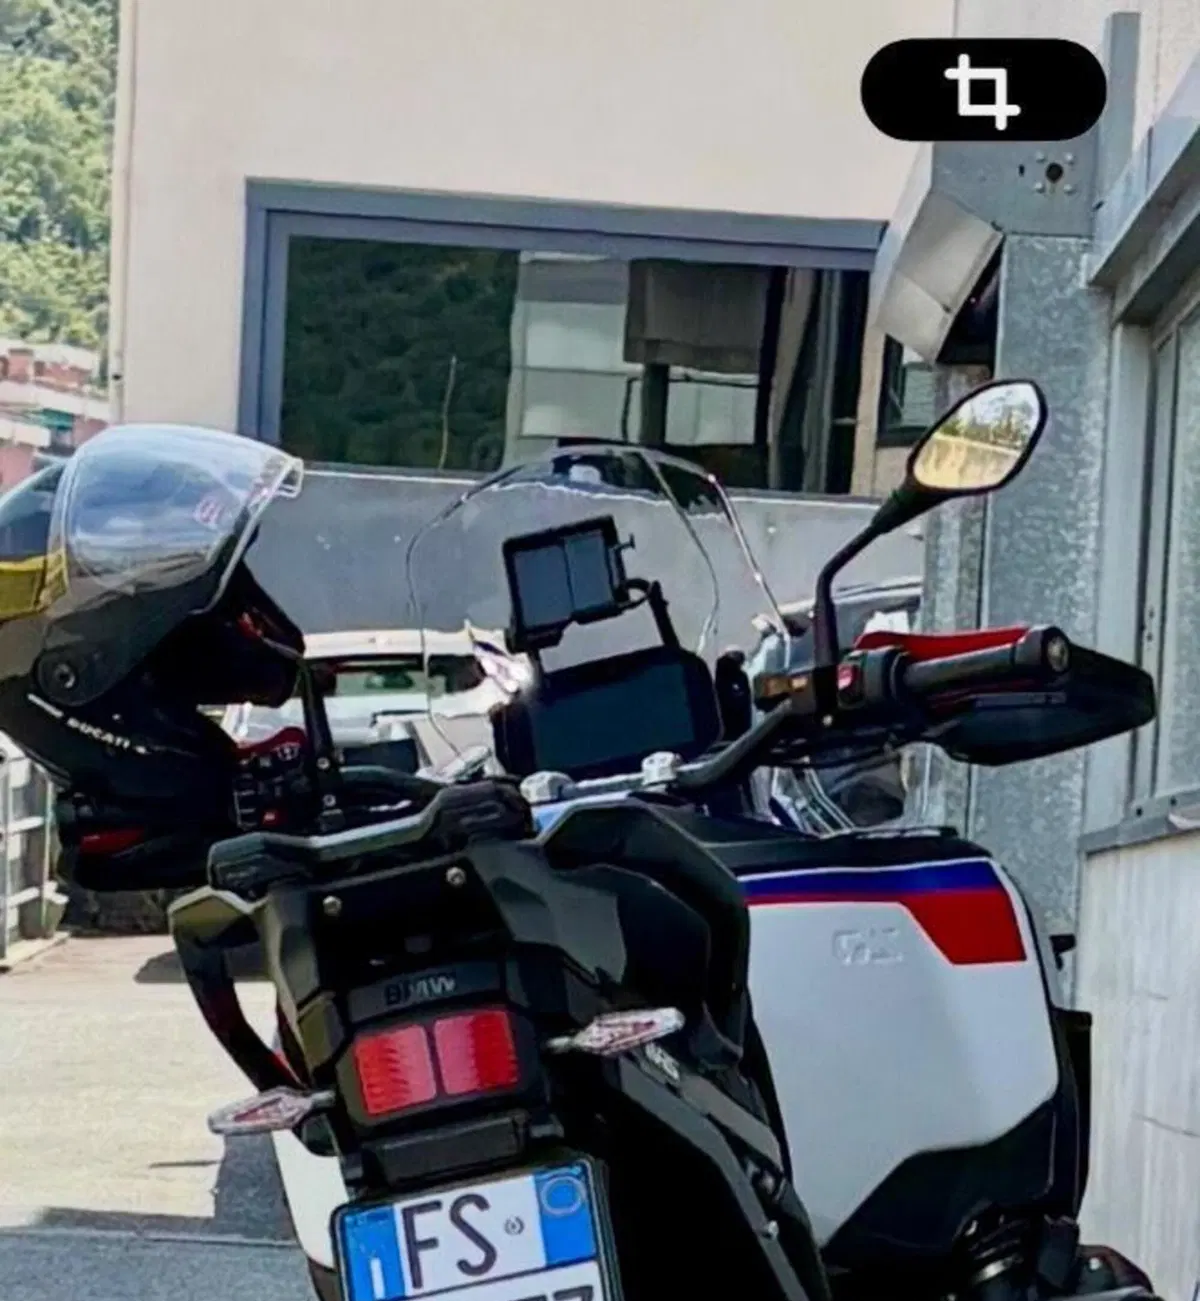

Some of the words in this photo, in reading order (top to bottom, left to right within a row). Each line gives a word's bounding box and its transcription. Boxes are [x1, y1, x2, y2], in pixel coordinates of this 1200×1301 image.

[67, 717, 130, 749] DUCATI
[384, 975, 456, 1006] BMW
[402, 1194, 498, 1289] FS
